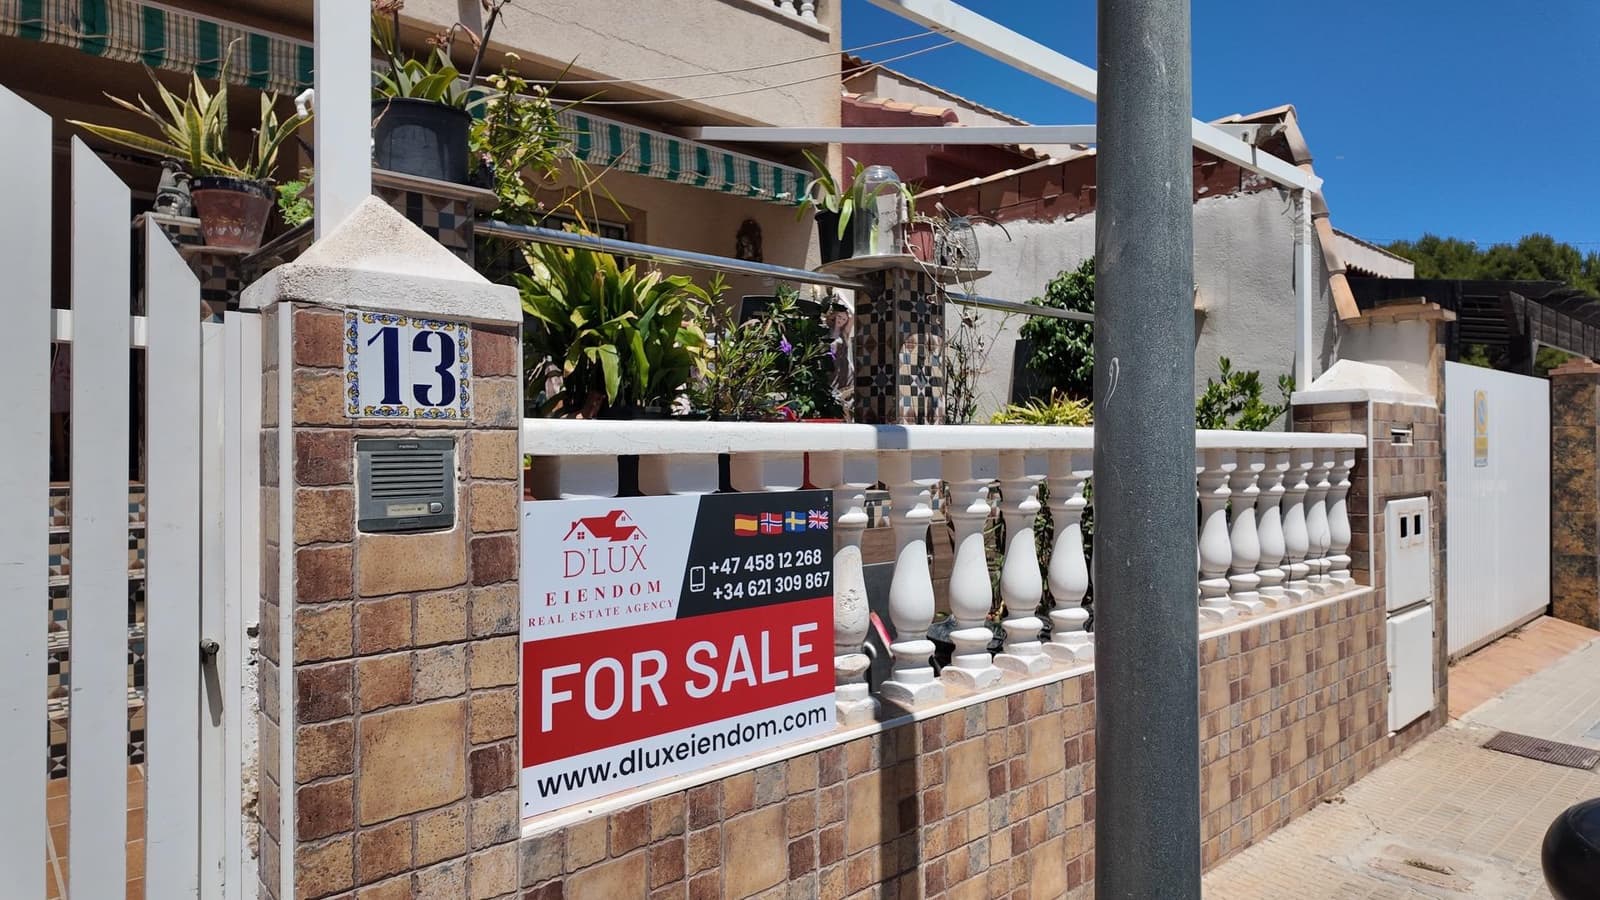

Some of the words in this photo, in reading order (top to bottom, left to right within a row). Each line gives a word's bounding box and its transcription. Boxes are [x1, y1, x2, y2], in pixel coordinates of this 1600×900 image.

[367, 326, 456, 407] 13
[563, 544, 647, 578] D'LUX
[709, 557, 741, 574] +47
[744, 553, 774, 572] 458
[778, 552, 792, 569] 12
[795, 549, 822, 567] 268
[545, 580, 662, 606] EIENDOM
[713, 583, 744, 600] +34
[748, 578, 771, 597] 621
[775, 575, 802, 593] 309
[805, 571, 830, 589] 867
[528, 614, 564, 628] REAL
[571, 606, 620, 622] ESTATE
[626, 600, 674, 615] AGENCY
[541, 649, 668, 733] FOR
[684, 622, 819, 699] SALE
[537, 706, 827, 798] www.dluxeiendom.com
